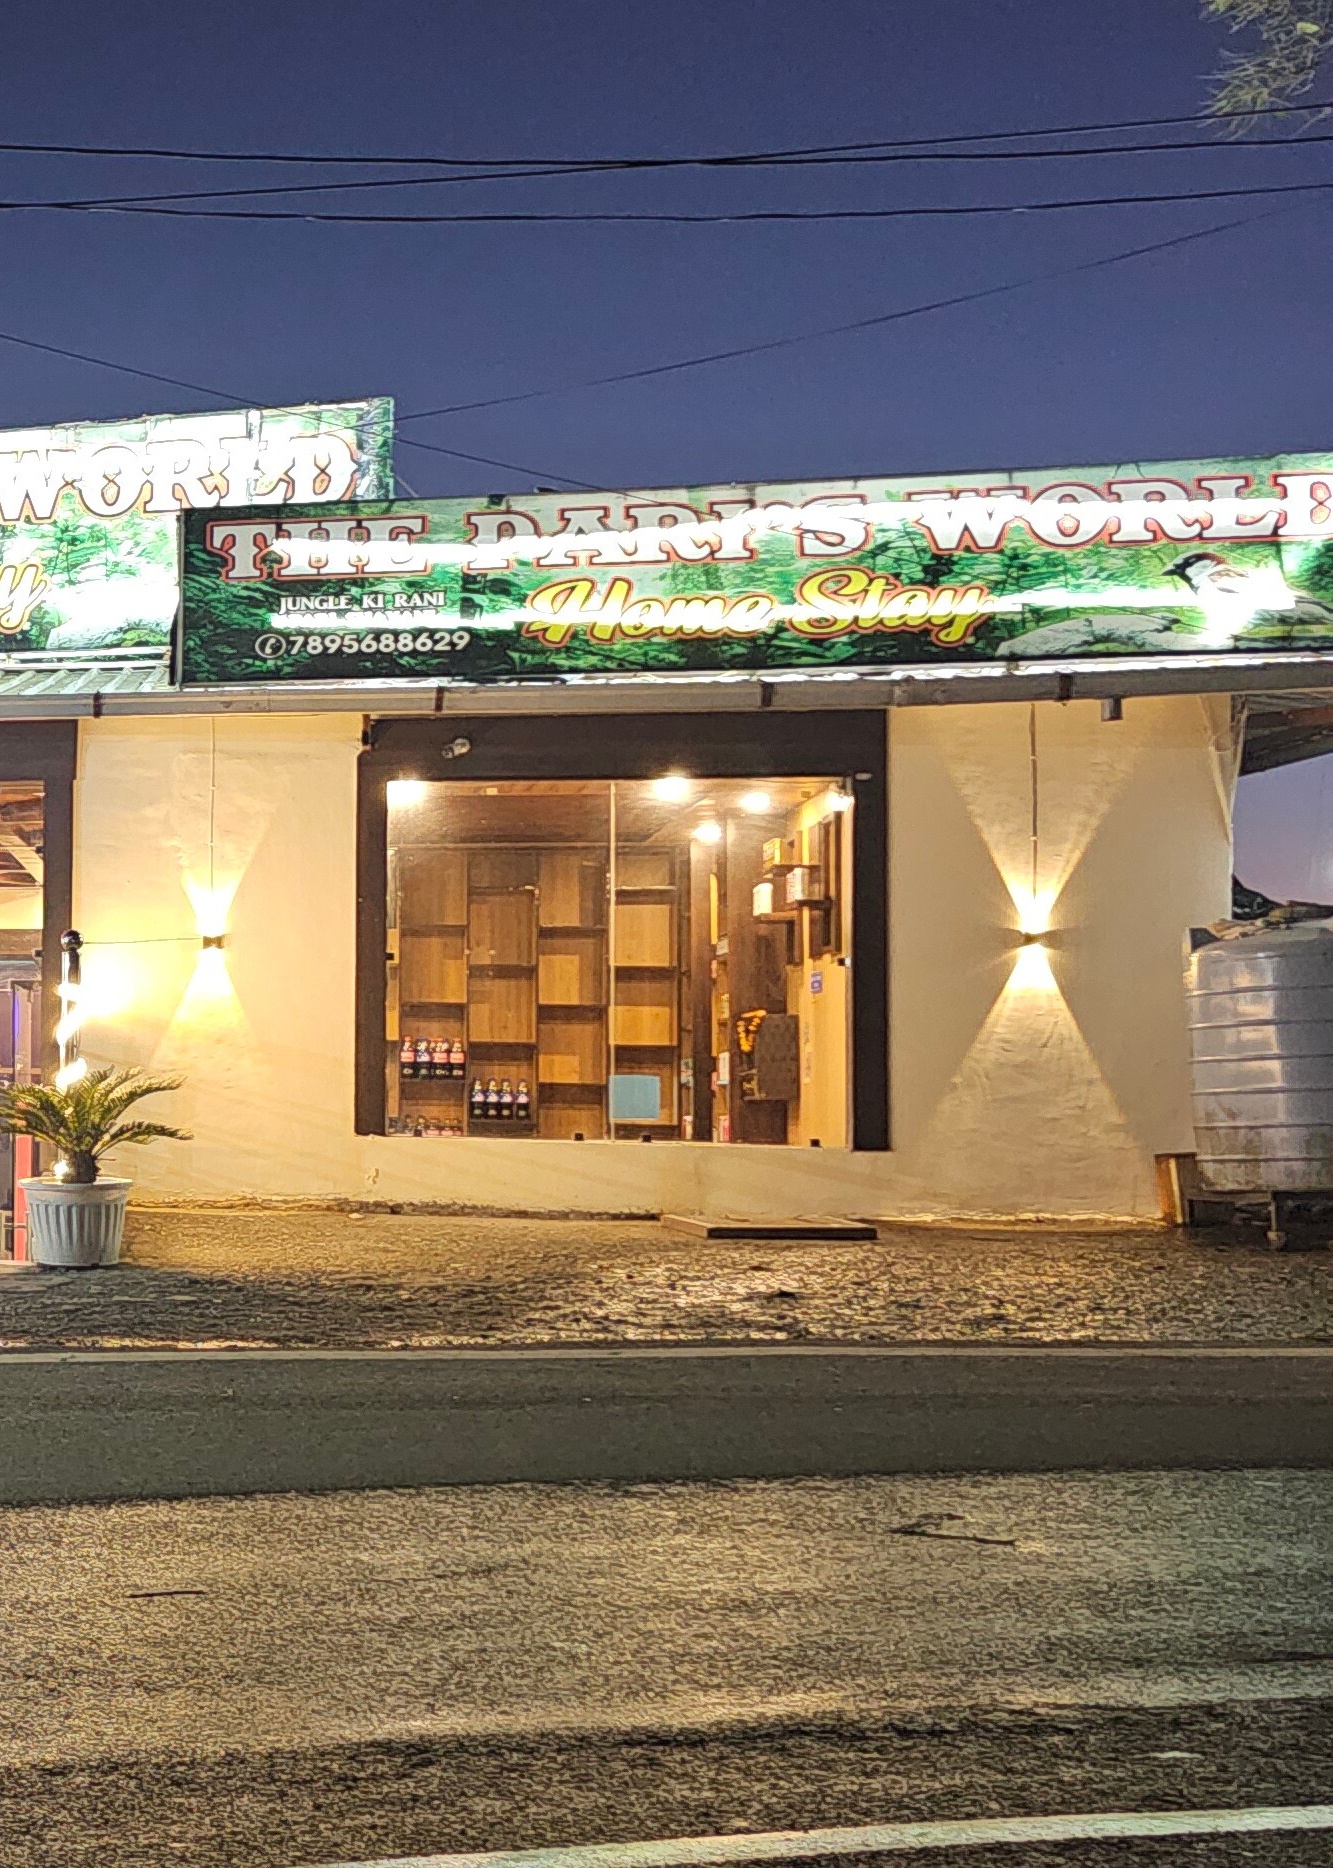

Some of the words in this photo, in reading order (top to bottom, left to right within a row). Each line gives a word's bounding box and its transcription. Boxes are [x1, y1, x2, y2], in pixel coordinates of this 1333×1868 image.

[205, 514, 429, 581] THE
[463, 492, 874, 573] PARI'S
[905, 472, 1333, 554] WORLD
[279, 594, 353, 614] JUNGLE
[362, 592, 385, 609] KI
[394, 590, 447, 608] RANI
[523, 576, 777, 647] Home
[789, 565, 995, 646] Stay
[289, 631, 471, 655] 7895688629
